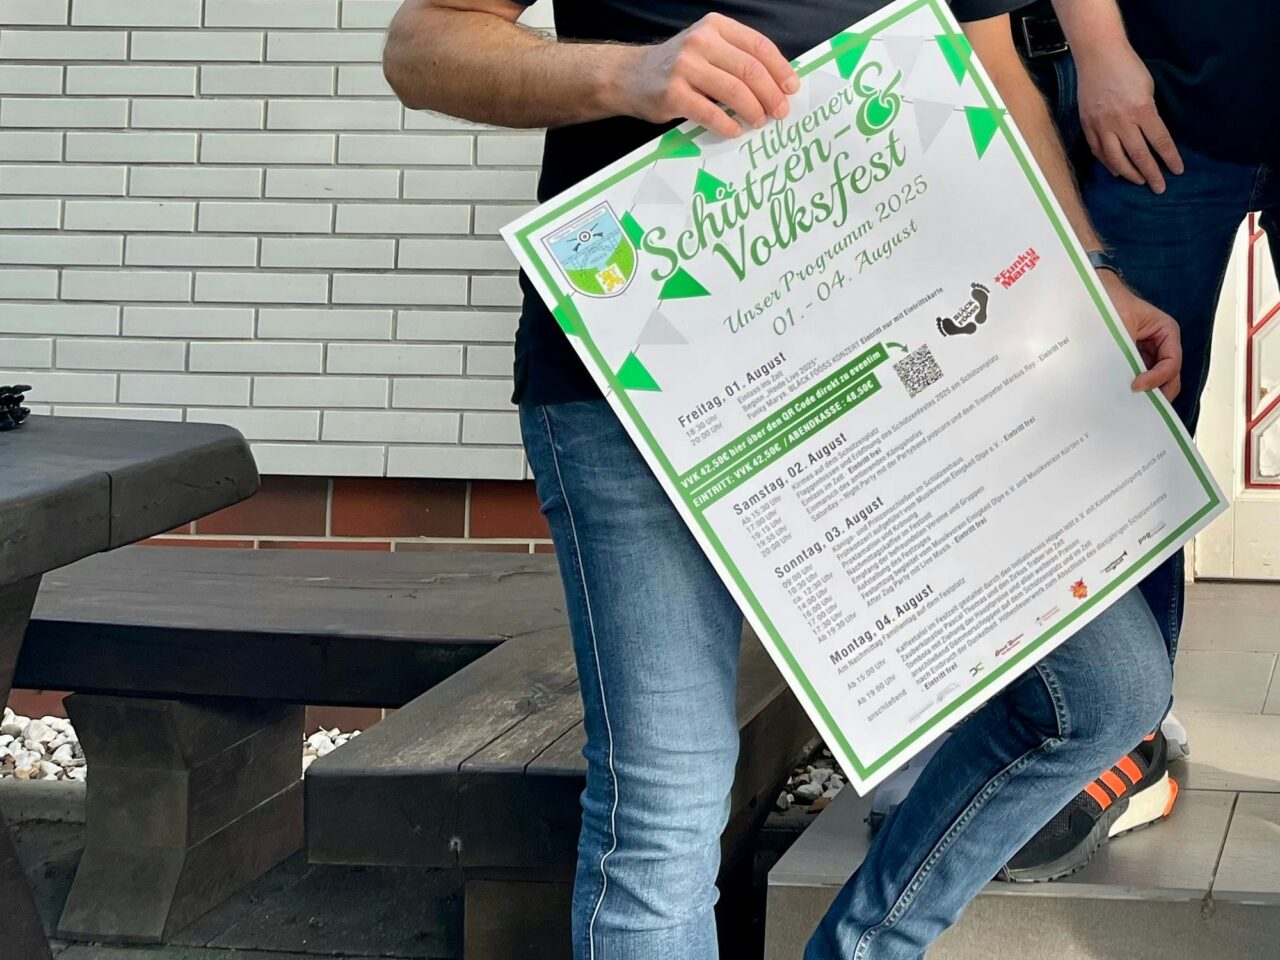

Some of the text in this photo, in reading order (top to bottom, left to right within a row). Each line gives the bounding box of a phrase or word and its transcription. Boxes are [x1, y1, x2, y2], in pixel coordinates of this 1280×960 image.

[739, 85, 854, 170] Hilgener
[853, 60, 902, 137] &
[713, 128, 906, 281] Volksfest
[723, 175, 928, 334] Unser Programm 2025
[854, 218, 918, 274] August
[1000, 248, 1036, 279] Funky
[1001, 255, 1040, 289] Marys
[678, 352, 786, 427] Freitag, 01. August
[680, 351, 880, 487] VVK 42,50€ hier über den QR Code direkt zu eventim
[692, 476, 734, 506] EINTRITT:
[733, 462, 752, 478] VVK
[752, 443, 781, 465] 42,50€
[788, 401, 841, 442] ABENDKASSE
[846, 380, 873, 402] 48,50€
[733, 432, 846, 514] Samstag, 02. August
[774, 496, 883, 578] Sonntag, 03. August
[829, 584, 933, 664] Montag, 04. August
